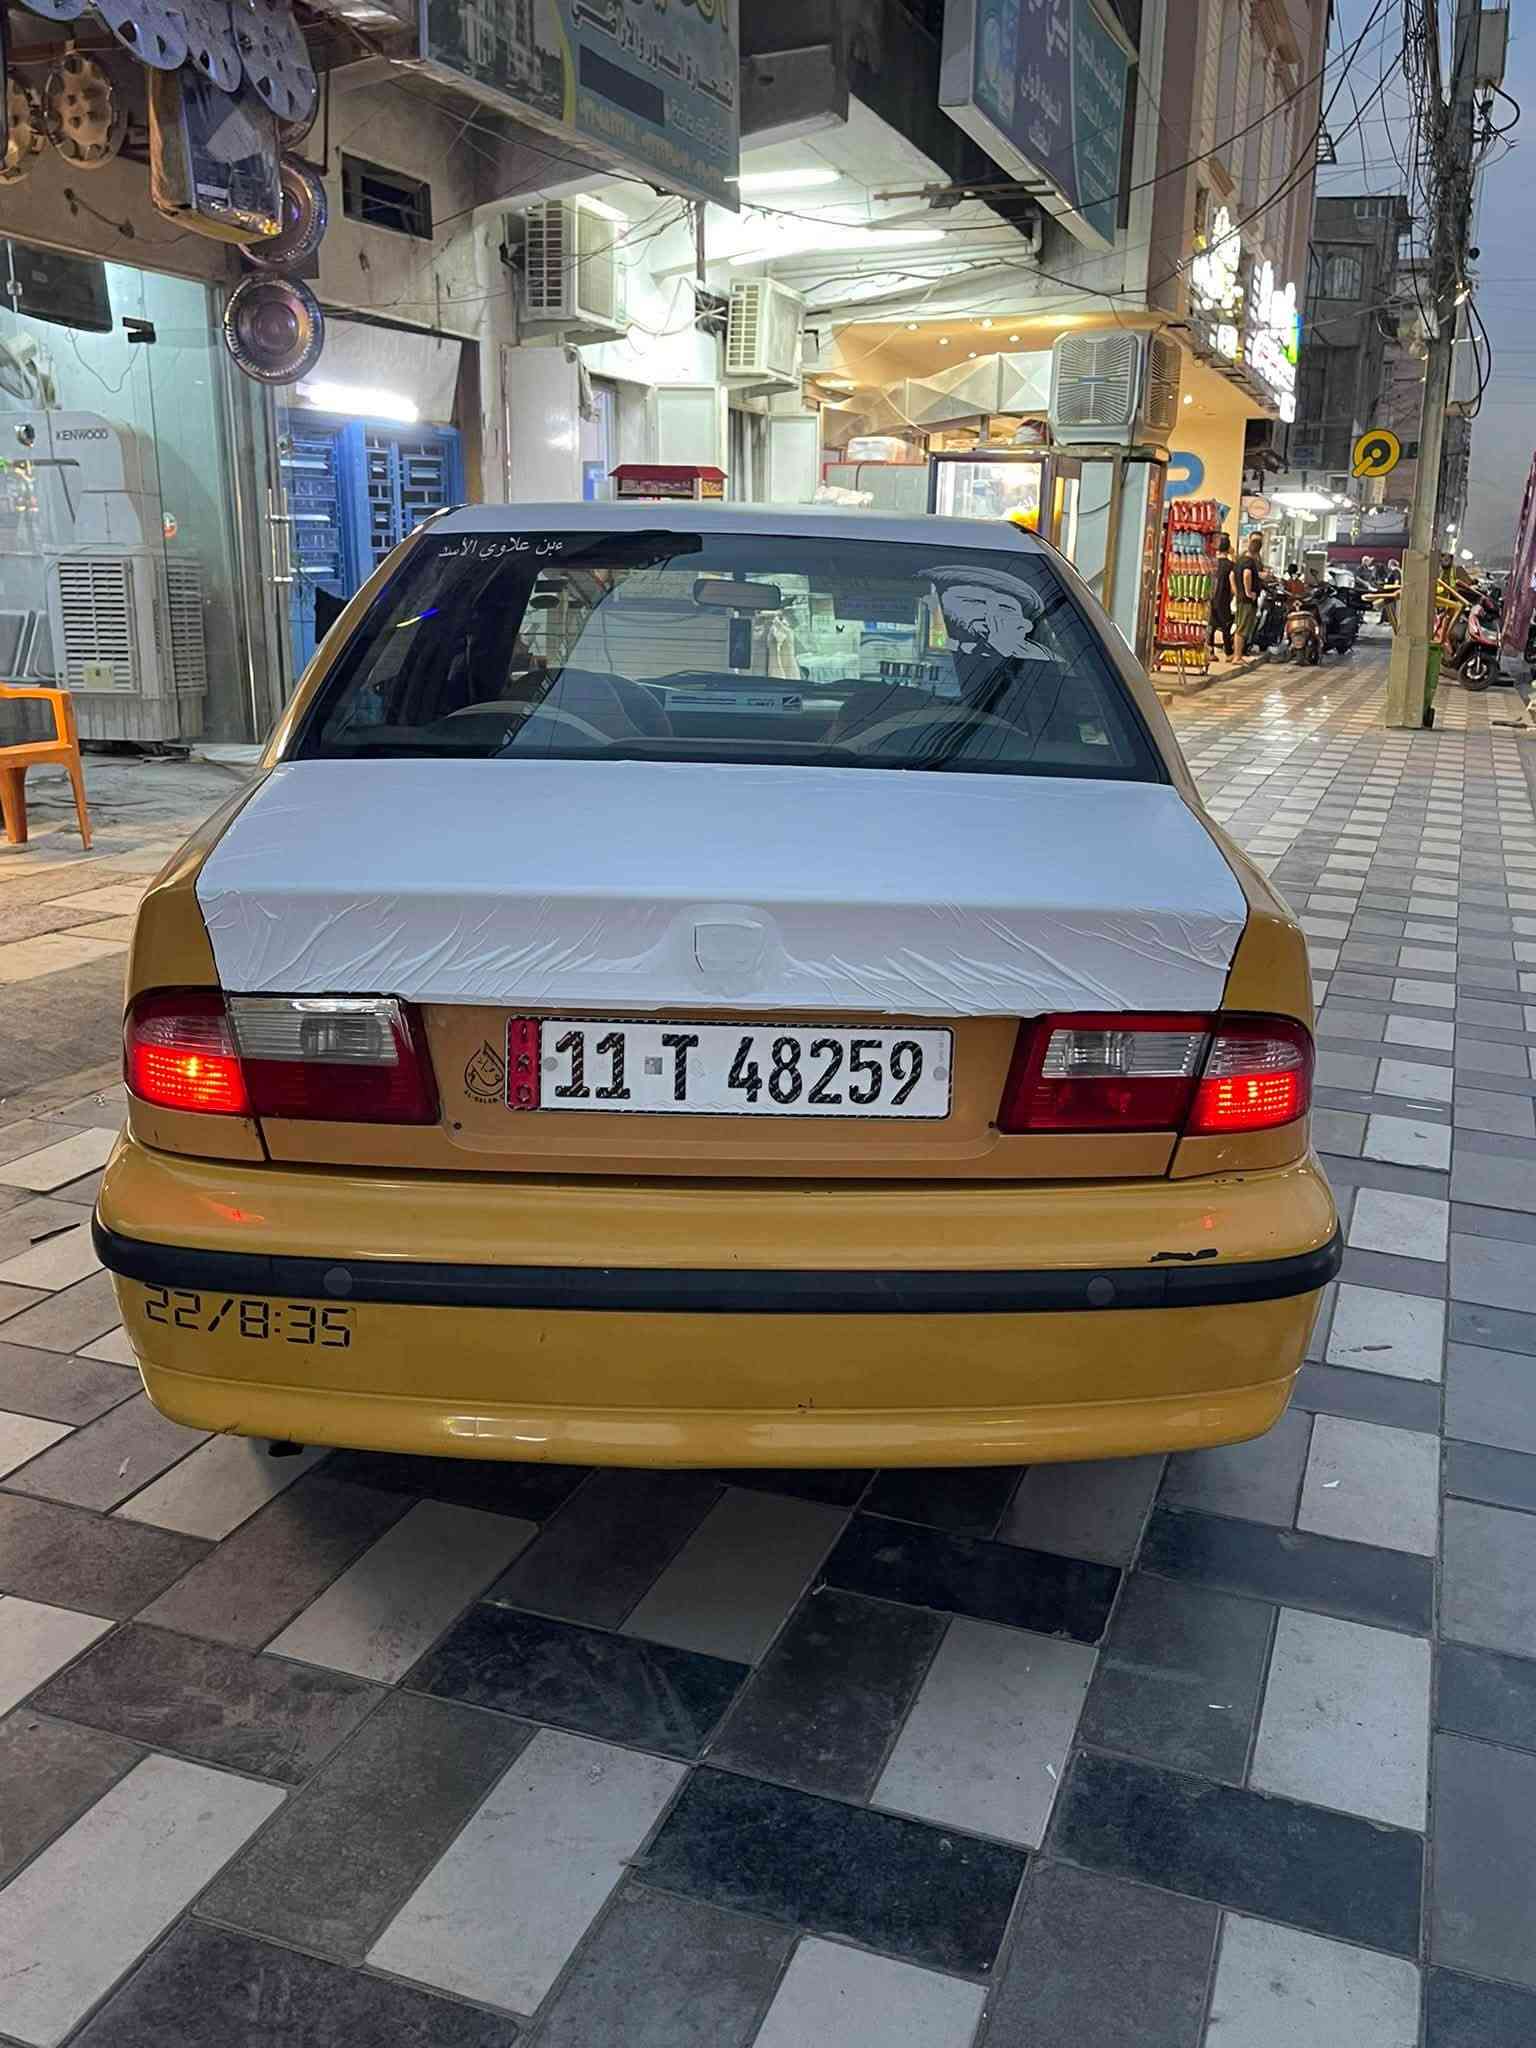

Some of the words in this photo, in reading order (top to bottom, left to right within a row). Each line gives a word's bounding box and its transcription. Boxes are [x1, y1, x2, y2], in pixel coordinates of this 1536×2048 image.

[55, 429, 108, 440] KENWOOD
[555, 1031, 630, 1099] 11
[662, 1034, 699, 1100] T
[728, 1036, 924, 1105] 48259
